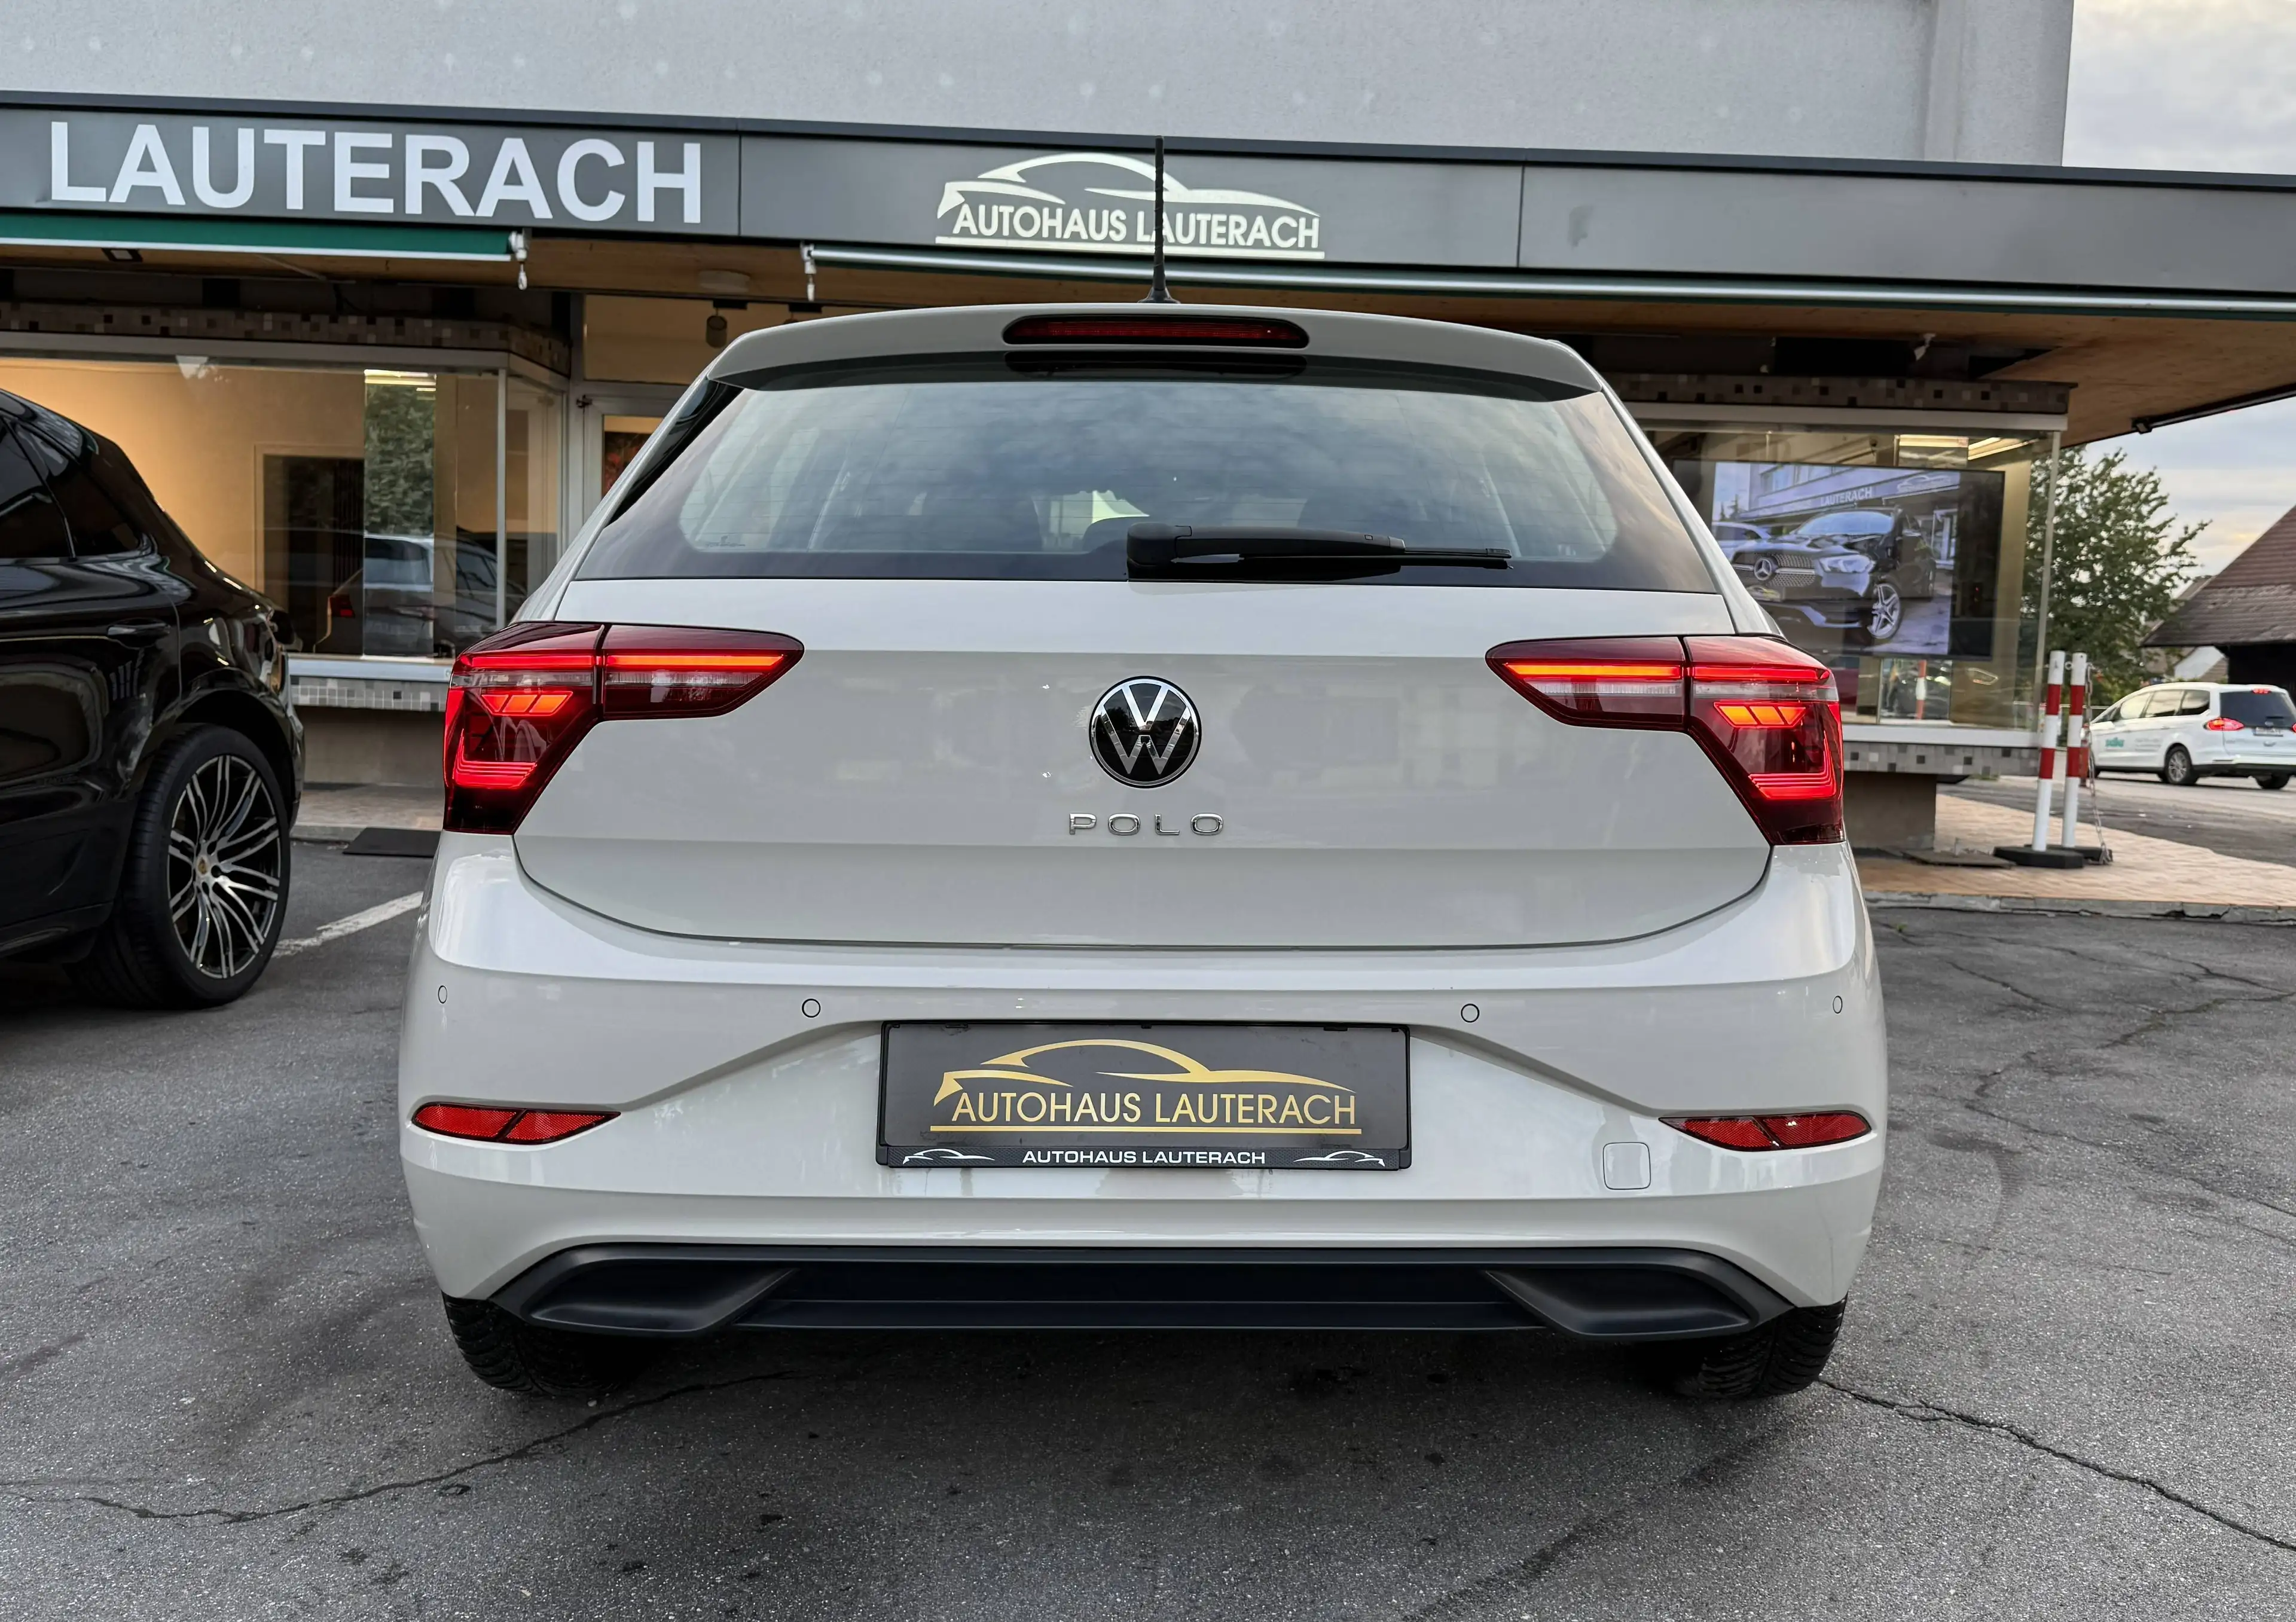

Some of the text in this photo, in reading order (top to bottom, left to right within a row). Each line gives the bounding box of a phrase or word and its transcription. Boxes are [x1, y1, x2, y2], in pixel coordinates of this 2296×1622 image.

[50, 121, 701, 224] LAUTERACH
[952, 203, 1320, 249] AUTOHAUS LAUTERACH
[1820, 486, 1873, 506] LAUTERACH
[1069, 813, 1224, 836] POLO
[951, 1092, 1356, 1125] AUTOHAUS LAUTERACH
[1021, 1150, 1266, 1165] AUTOHAUS LAUTERACH
